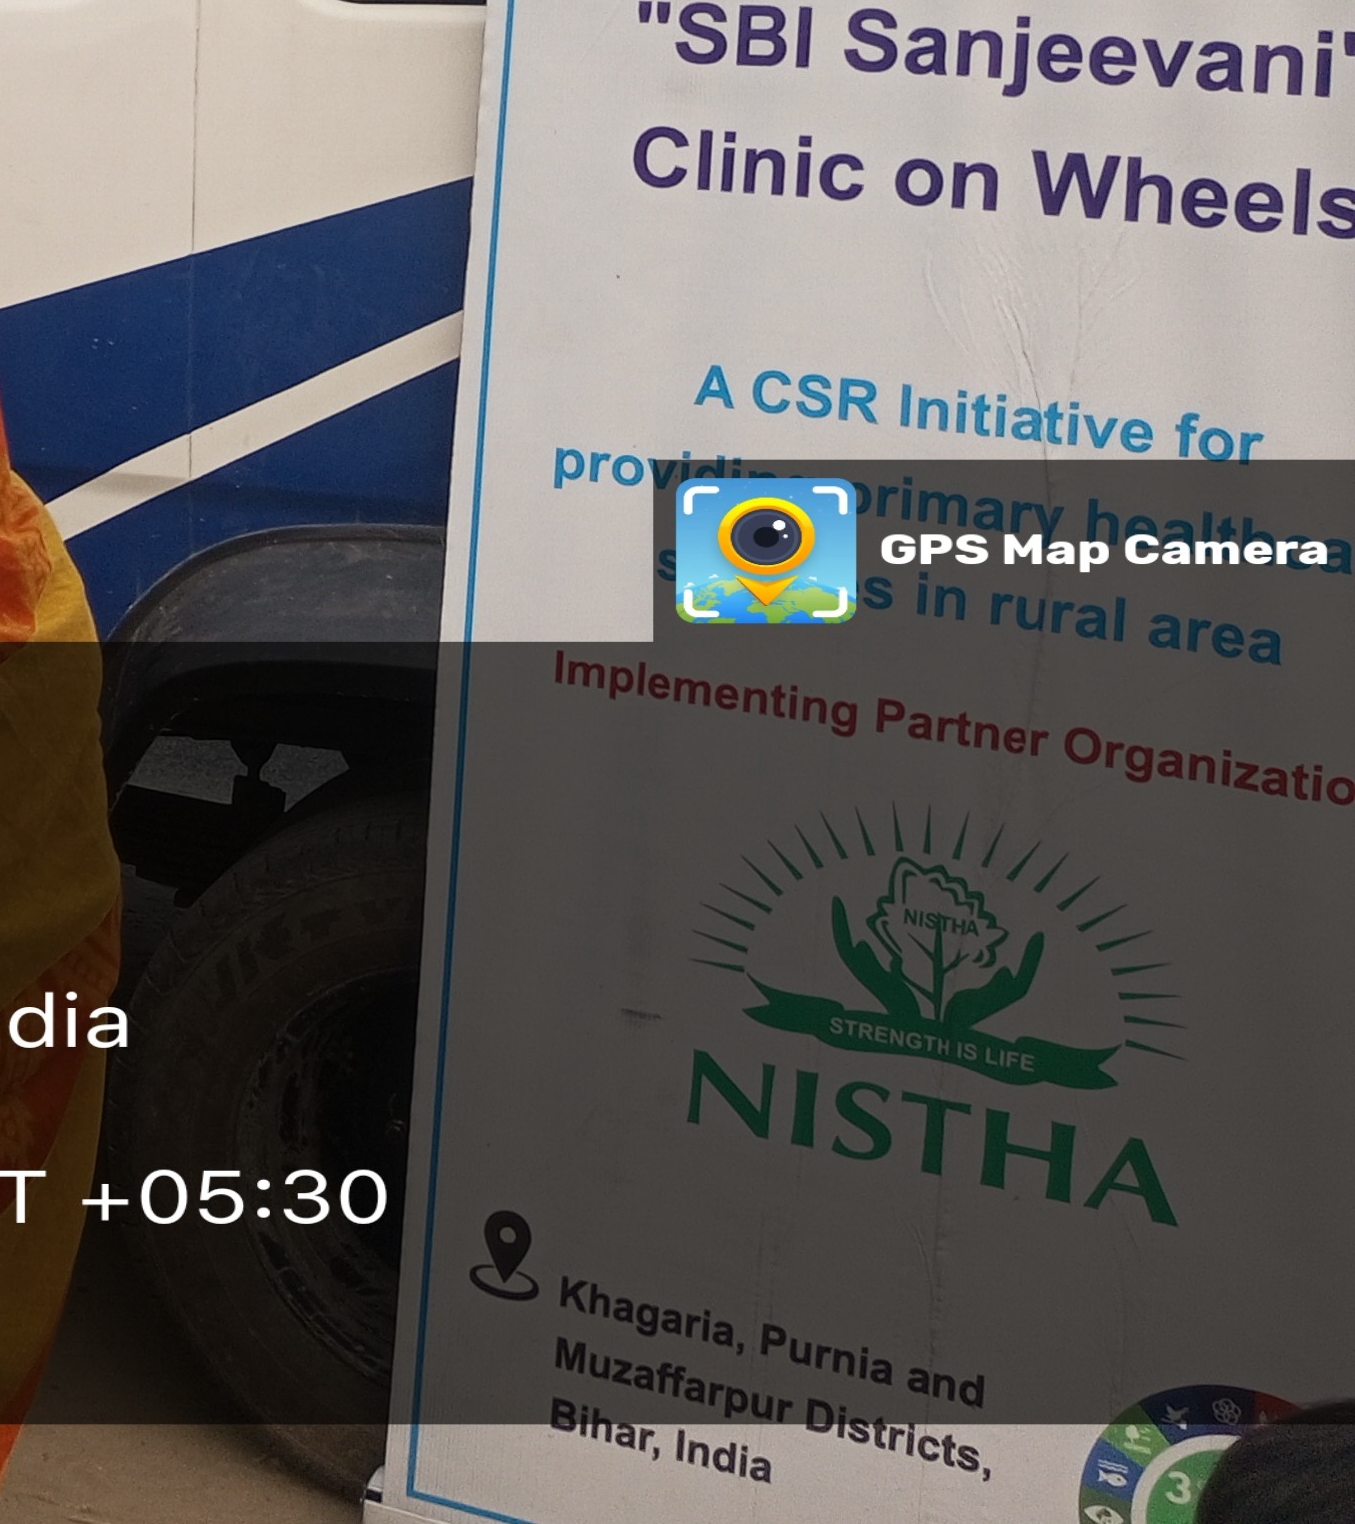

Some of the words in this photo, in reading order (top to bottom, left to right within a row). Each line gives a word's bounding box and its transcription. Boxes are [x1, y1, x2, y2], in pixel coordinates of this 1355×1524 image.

[637, 1, 813, 68] "SBI
[632, 126, 866, 202] Clinic
[894, 159, 1000, 212] on
[693, 364, 735, 410] A
[751, 370, 879, 426] CSR
[899, 383, 1156, 454] Initiative
[1175, 412, 1265, 466] for
[916, 571, 967, 622] in
[990, 592, 1127, 643] rural
[1148, 612, 1284, 666] area
[553, 649, 858, 738] Implementing
[875, 697, 1050, 758] Partner
[1064, 726, 1355, 807] Organizatio
[902, 907, 980, 939] NISTHA
[828, 1016, 951, 1057] STRENGTH
[956, 1041, 978, 1062] IS
[985, 1046, 1035, 1073] LIFE
[687, 1048, 1179, 1228] NISTHA
[559, 1276, 745, 1356] Khagaria,
[759, 1322, 893, 1387] Purnia
[906, 1364, 987, 1409] and
[550, 1396, 662, 1462] Bihar,
[675, 1428, 772, 1485] India
[554, 1336, 794, 1426] Muzaffarpur
[805, 1398, 992, 1483] Districts,
[1164, 1470, 1192, 1506] 3
